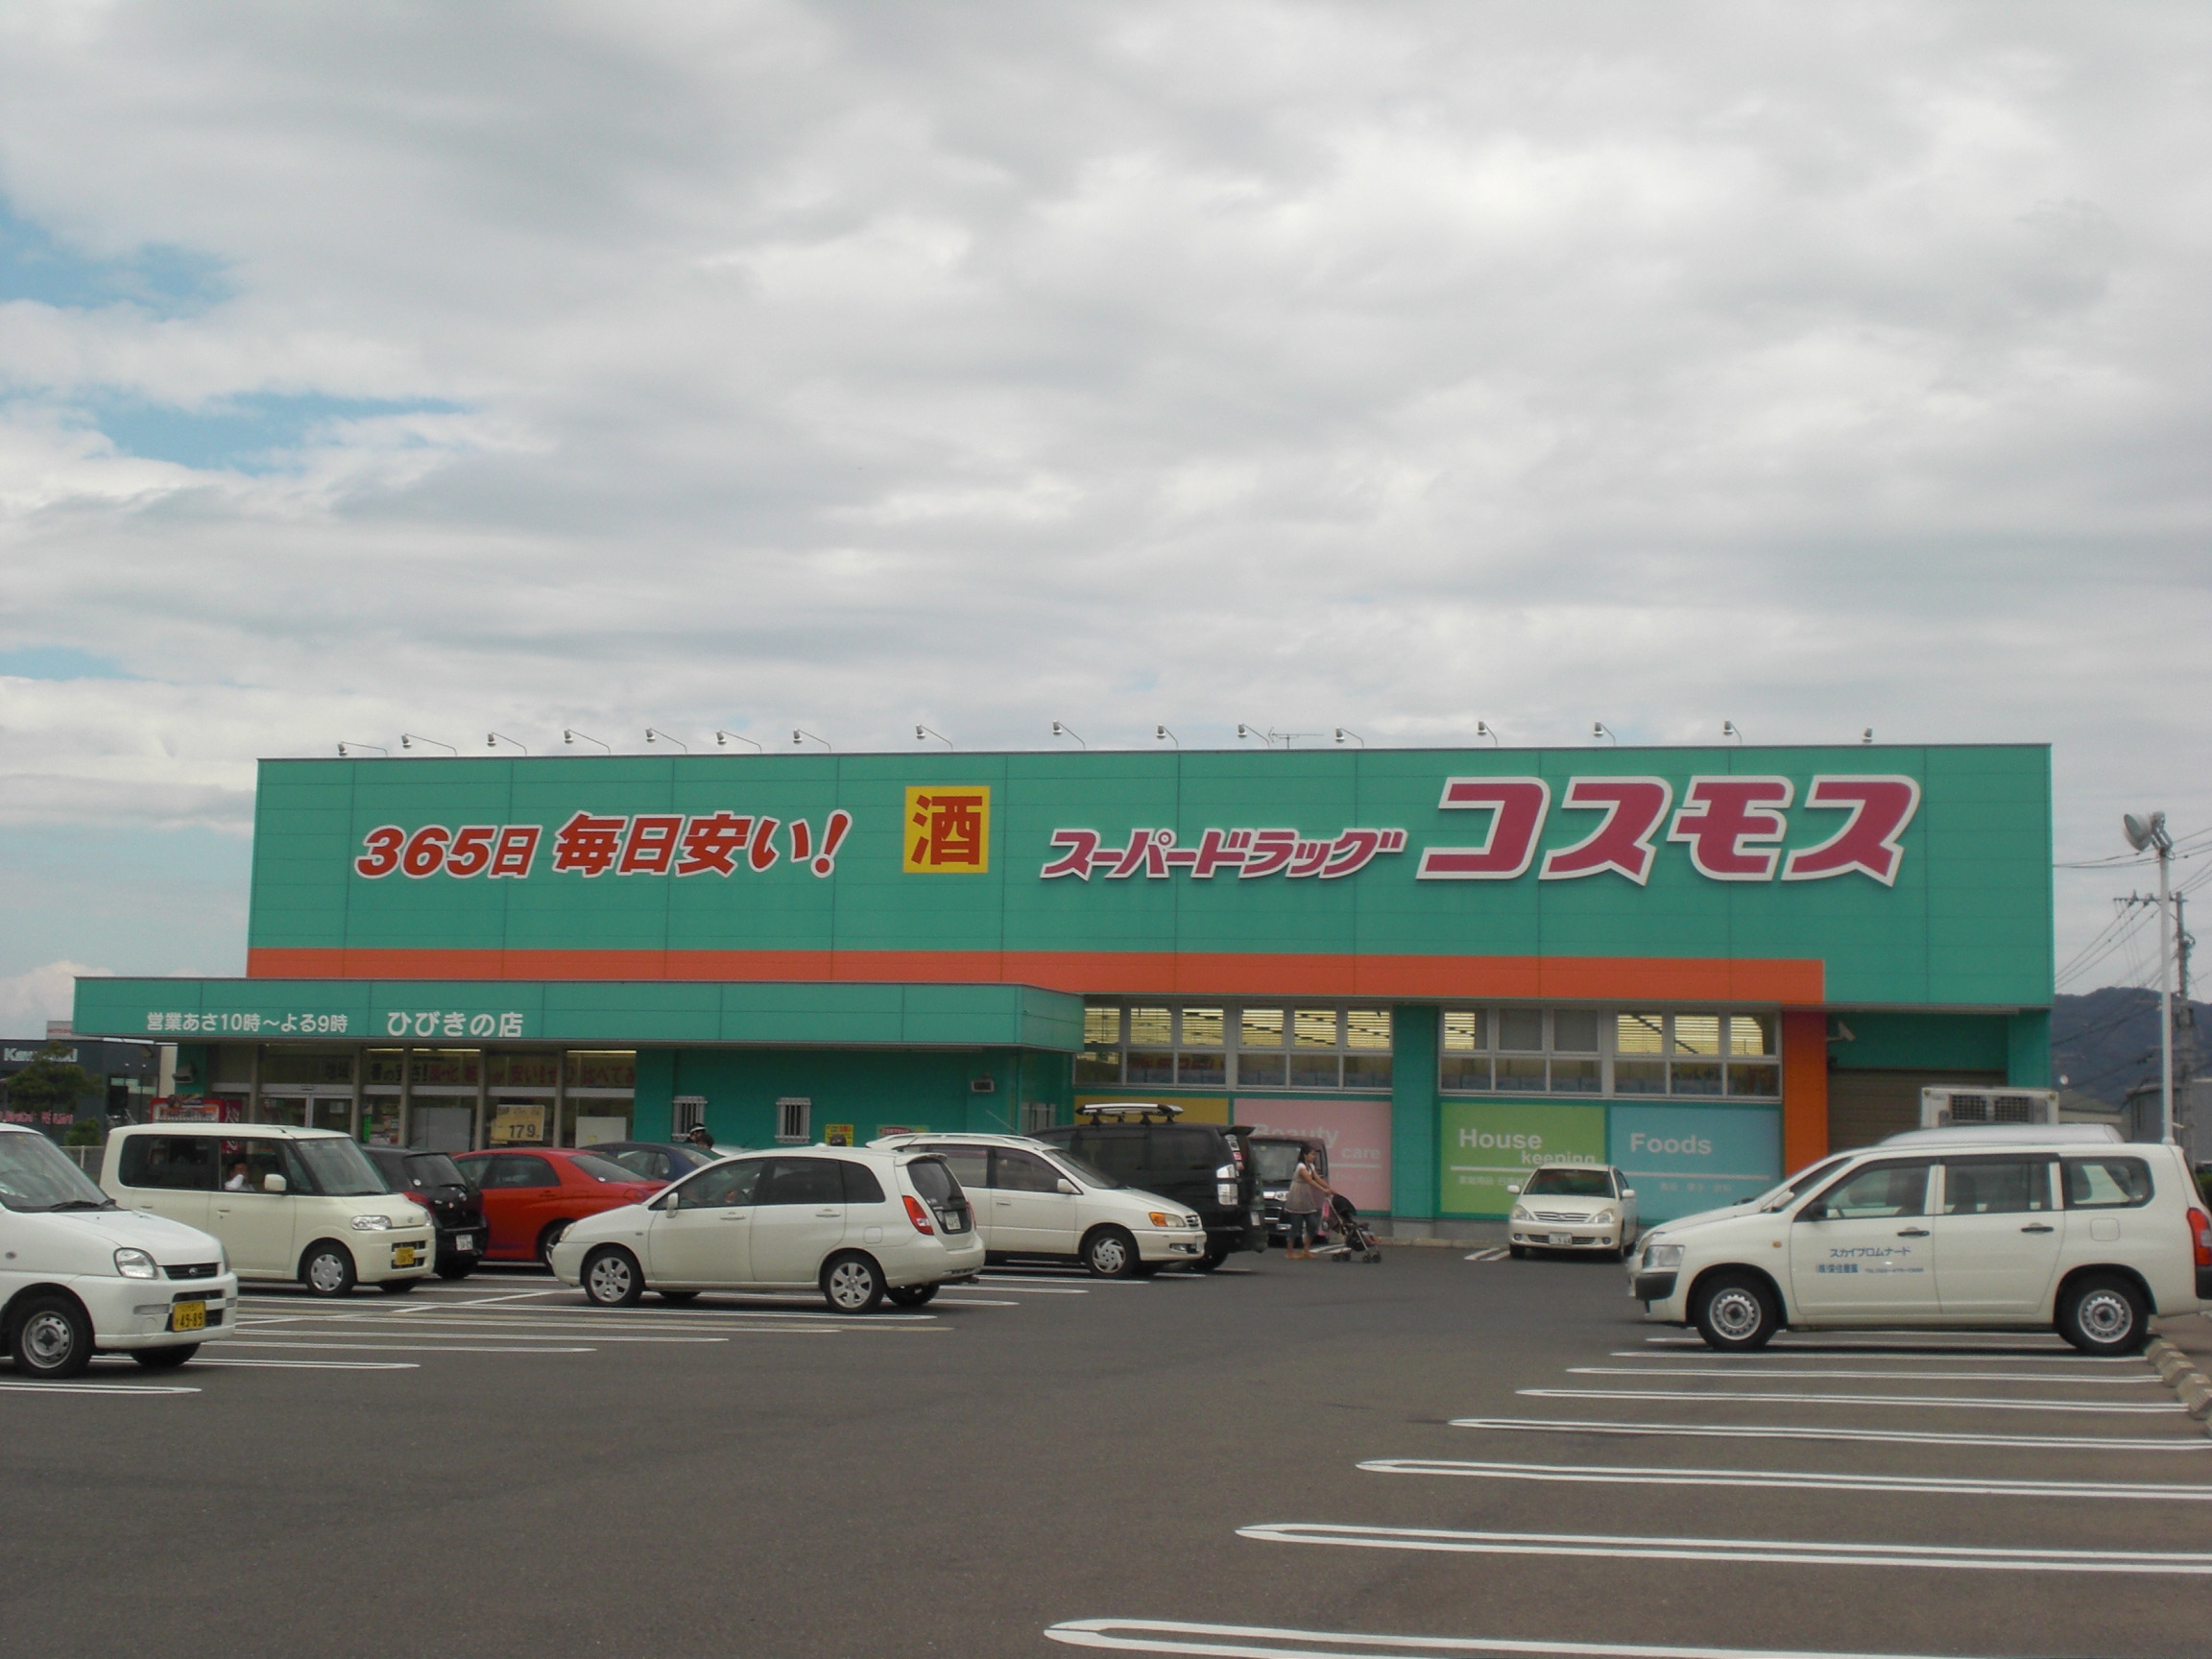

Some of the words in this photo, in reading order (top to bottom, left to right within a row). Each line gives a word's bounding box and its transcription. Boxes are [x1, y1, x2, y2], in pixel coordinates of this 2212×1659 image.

[911, 795, 983, 866] 酒
[1040, 828, 1408, 881] スーパードラッグ
[1415, 775, 1922, 886] コスモス
[386, 1011, 524, 1038] ひびきの店
[1459, 1128, 1542, 1149] House
[1630, 1133, 1713, 1154] Foods
[1341, 1146, 1381, 1160] care
